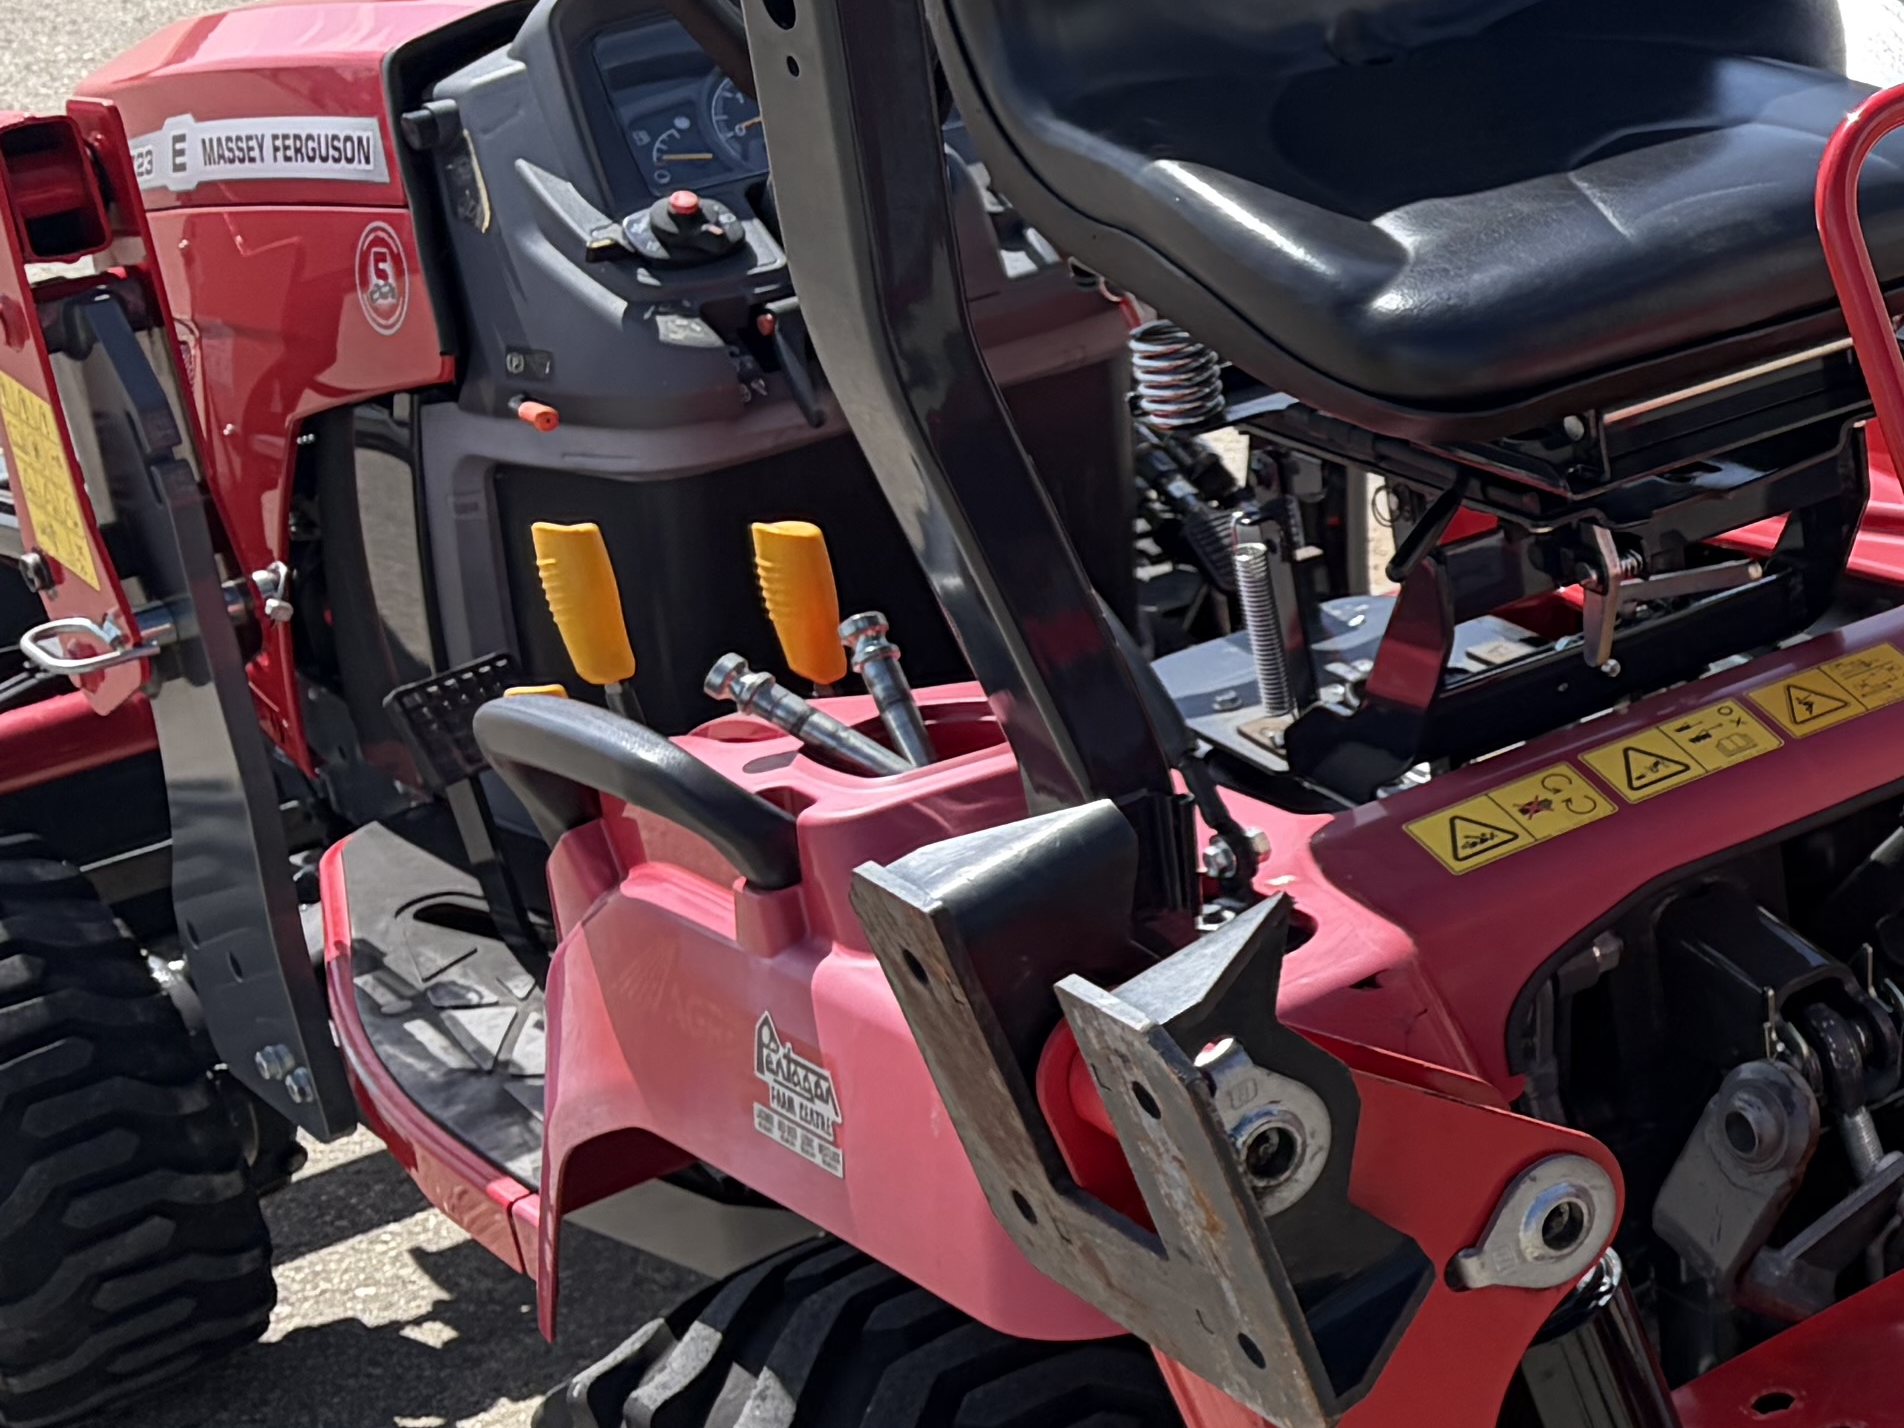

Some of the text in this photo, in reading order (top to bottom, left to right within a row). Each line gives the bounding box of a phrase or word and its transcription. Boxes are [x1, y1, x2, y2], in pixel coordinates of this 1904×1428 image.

[131, 132, 188, 176] 23 E
[201, 132, 371, 167] MASSEY FERGUSON
